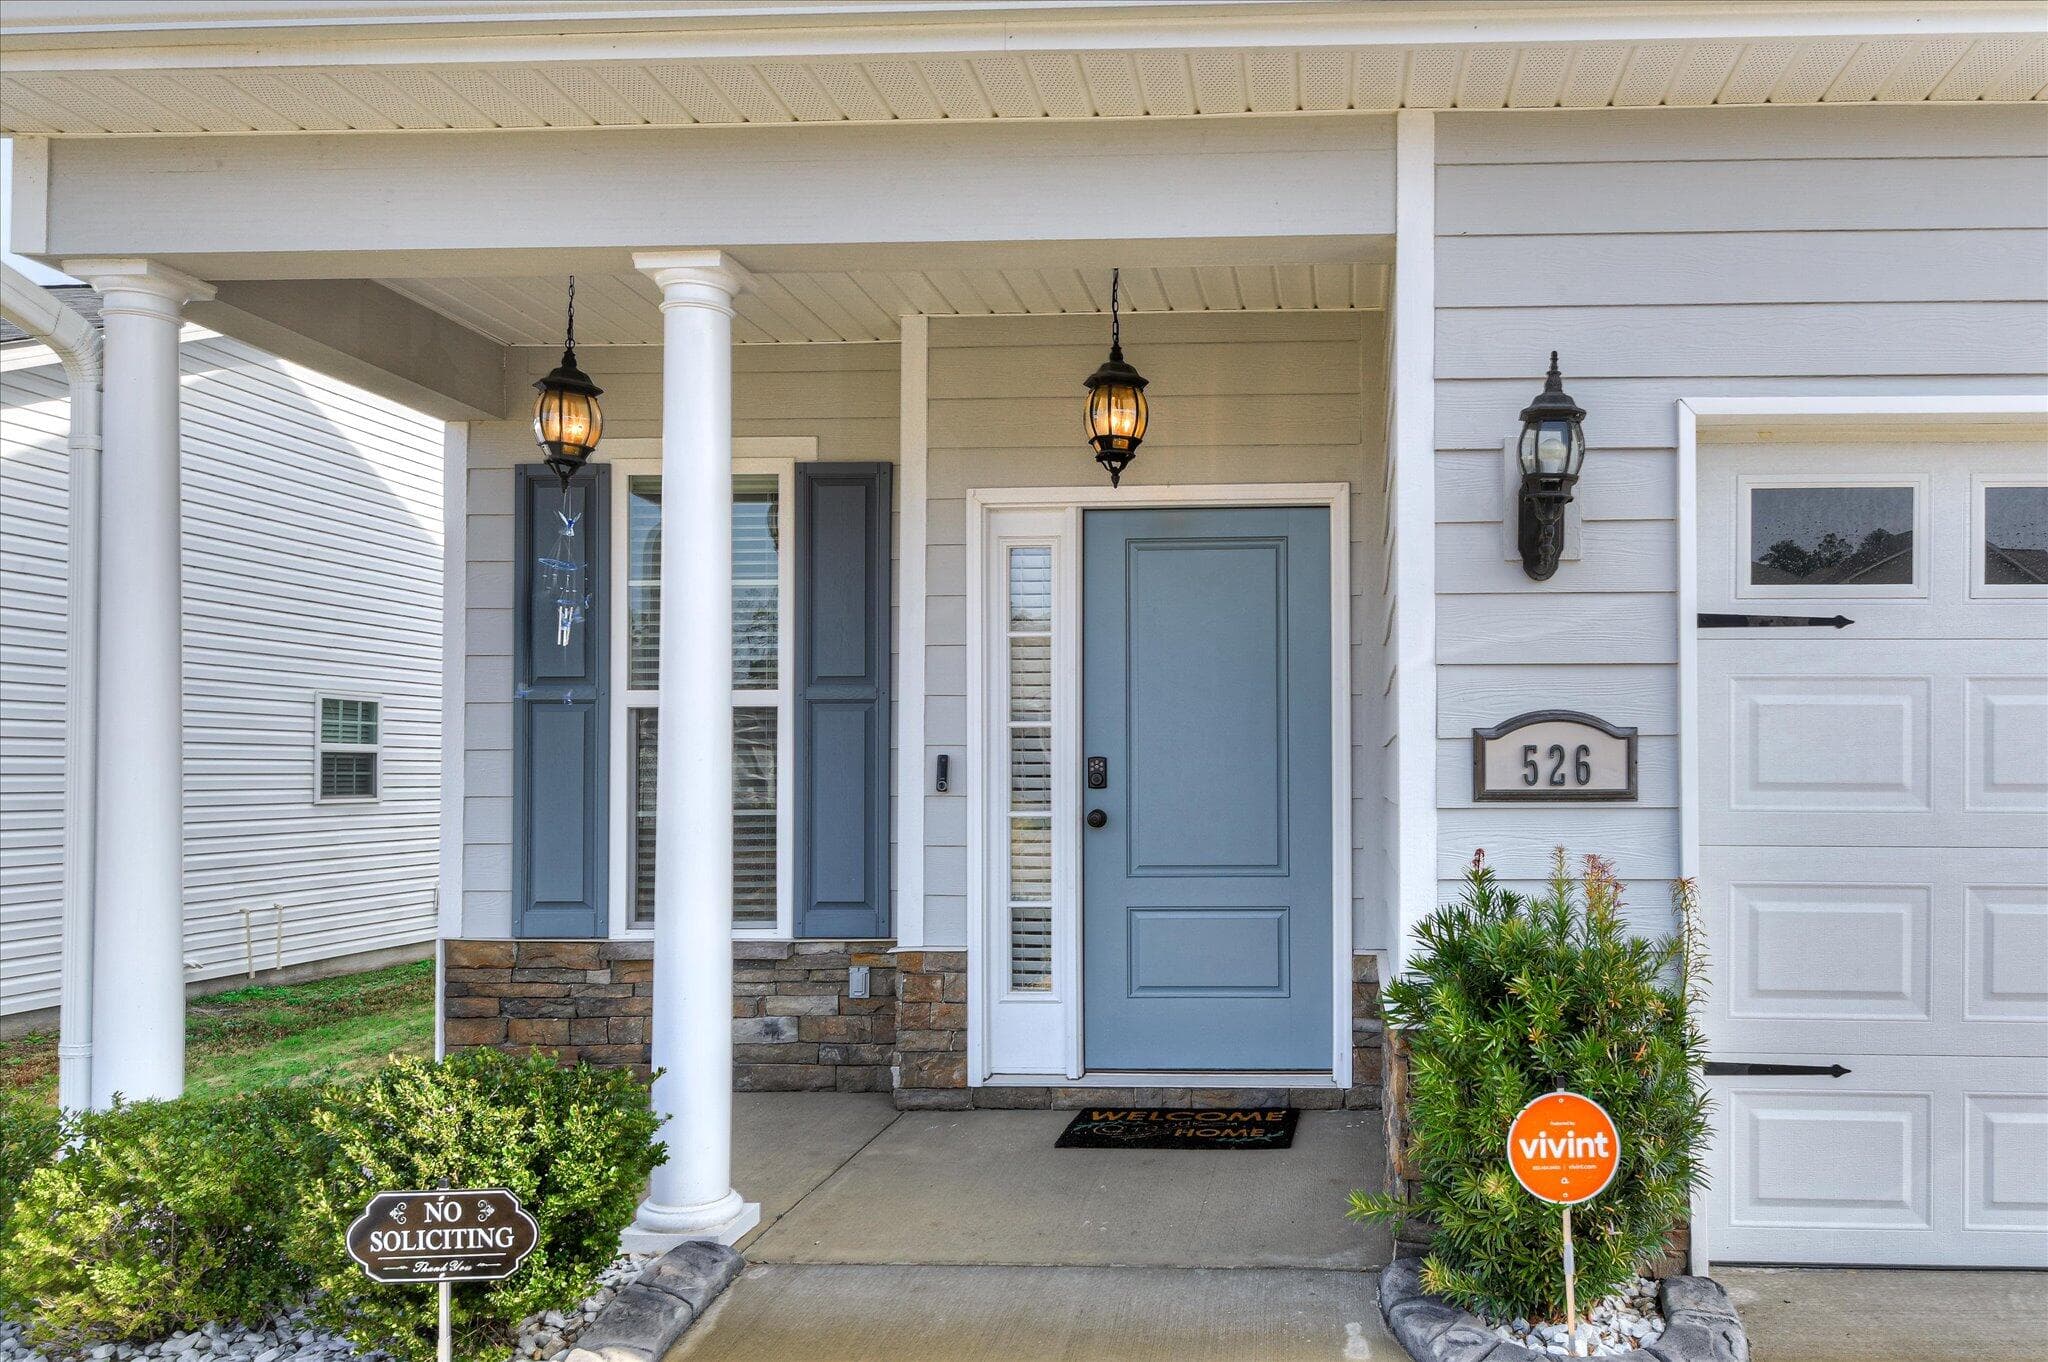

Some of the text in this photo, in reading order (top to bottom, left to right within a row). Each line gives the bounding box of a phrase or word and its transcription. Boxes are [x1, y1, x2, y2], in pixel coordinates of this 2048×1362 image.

[1522, 744, 1591, 786] 526
[1092, 1110, 1285, 1121] WELCOME
[1174, 1128, 1266, 1137] HOME
[1518, 1130, 1609, 1159] vivint
[424, 1201, 462, 1223] NO
[370, 1227, 515, 1252] SOLICITING
[412, 1259, 473, 1273] Thank You
